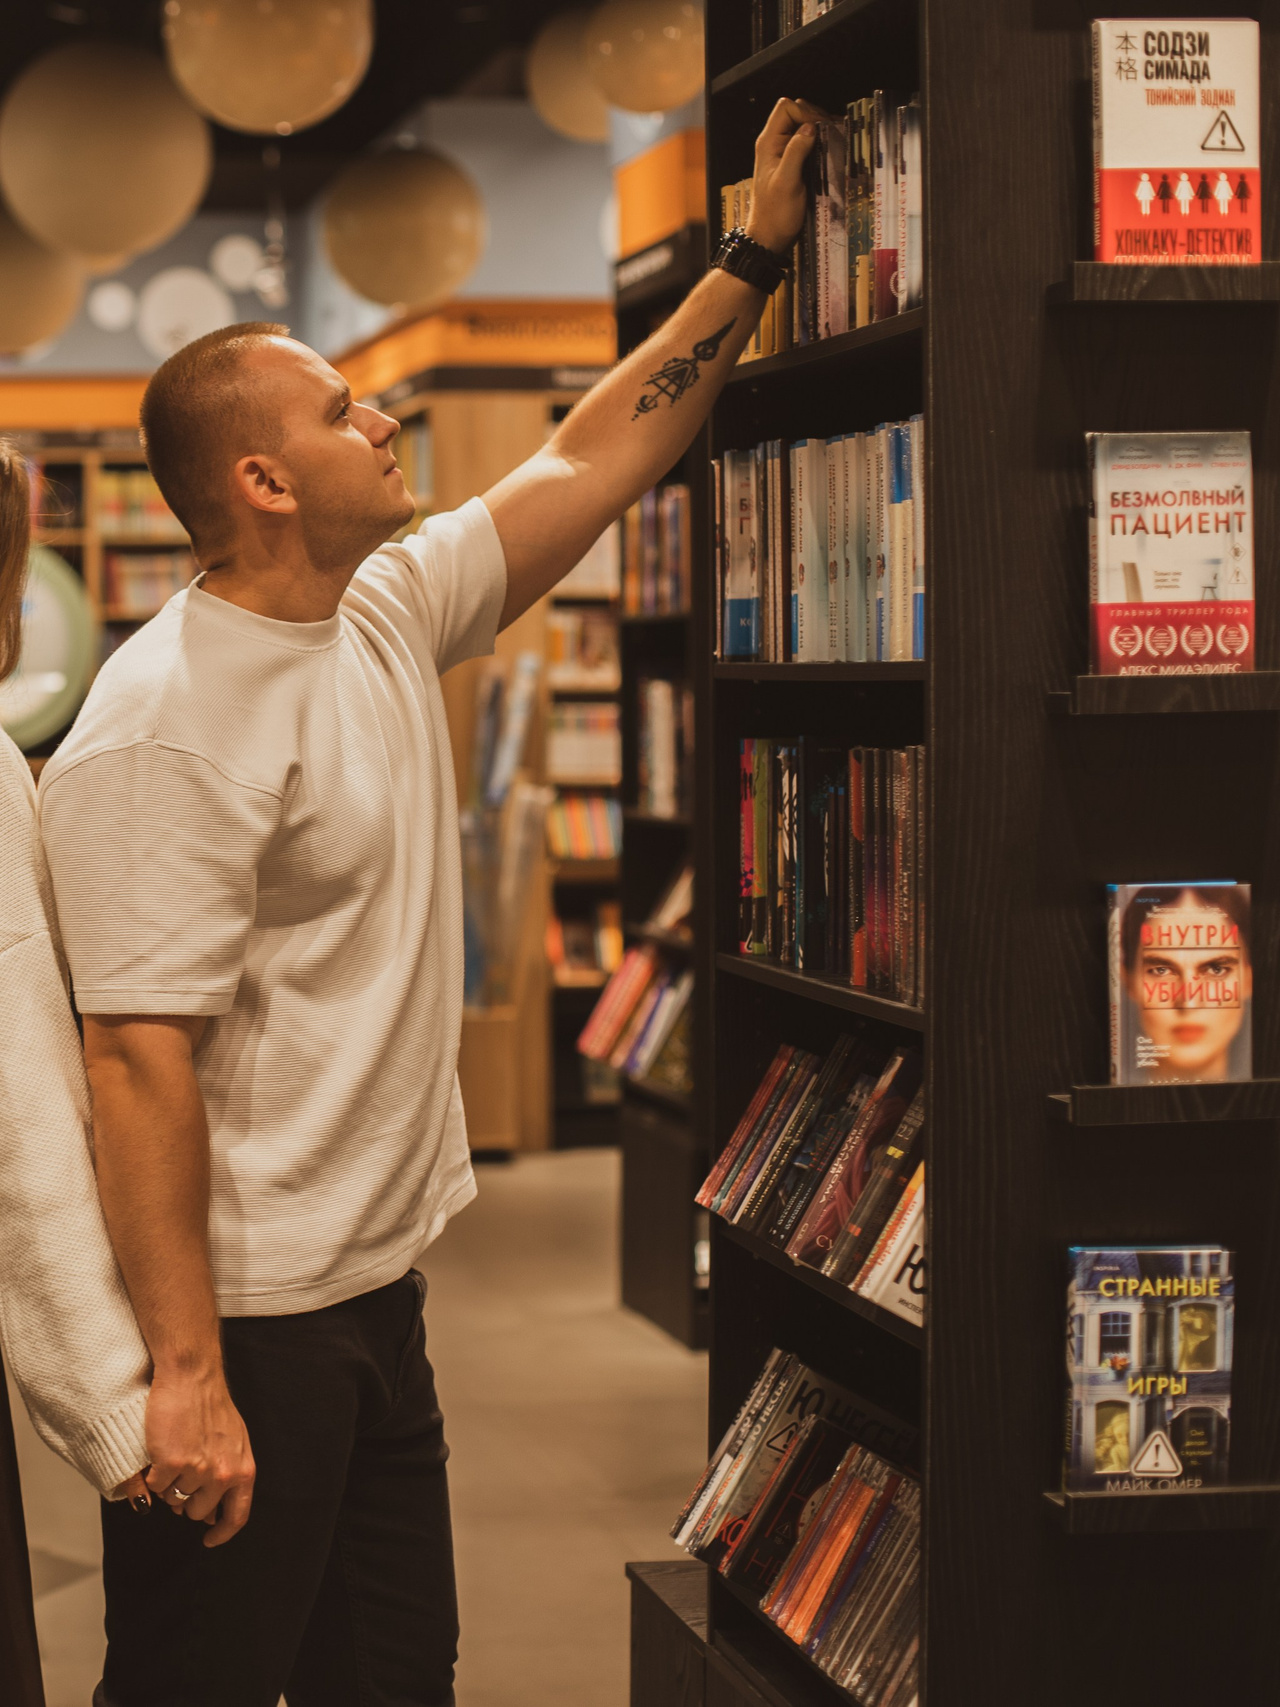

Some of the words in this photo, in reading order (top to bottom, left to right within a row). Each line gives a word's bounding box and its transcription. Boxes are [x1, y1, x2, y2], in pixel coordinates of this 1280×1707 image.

[1115, 30, 1138, 81] 本格
[1143, 30, 1210, 59] СОДЗИ
[1144, 60, 1211, 83] СИМАДА
[1145, 86, 1196, 106] ТОКИЙСКИЙ
[1200, 88, 1236, 107] ЗОДИАК
[1110, 484, 1246, 508] БЕЗМОЛВНЫЙ
[1110, 511, 1247, 538] ПАЦИЕНТ
[1110, 607, 1161, 617] ГЛАВНЫЙ
[1167, 607, 1215, 616] ТРИЛЛЕР
[1220, 606, 1249, 615] ГОДА
[1141, 924, 1238, 946] ВНУТРИ
[1143, 976, 1239, 1006] УБИЙЦЫ
[1099, 1278, 1220, 1297] СТРАННЫЕ
[1127, 1377, 1187, 1395] ИГРЫ
[1106, 1477, 1153, 1491] МАЙК
[1157, 1478, 1203, 1490] ОМЕР
